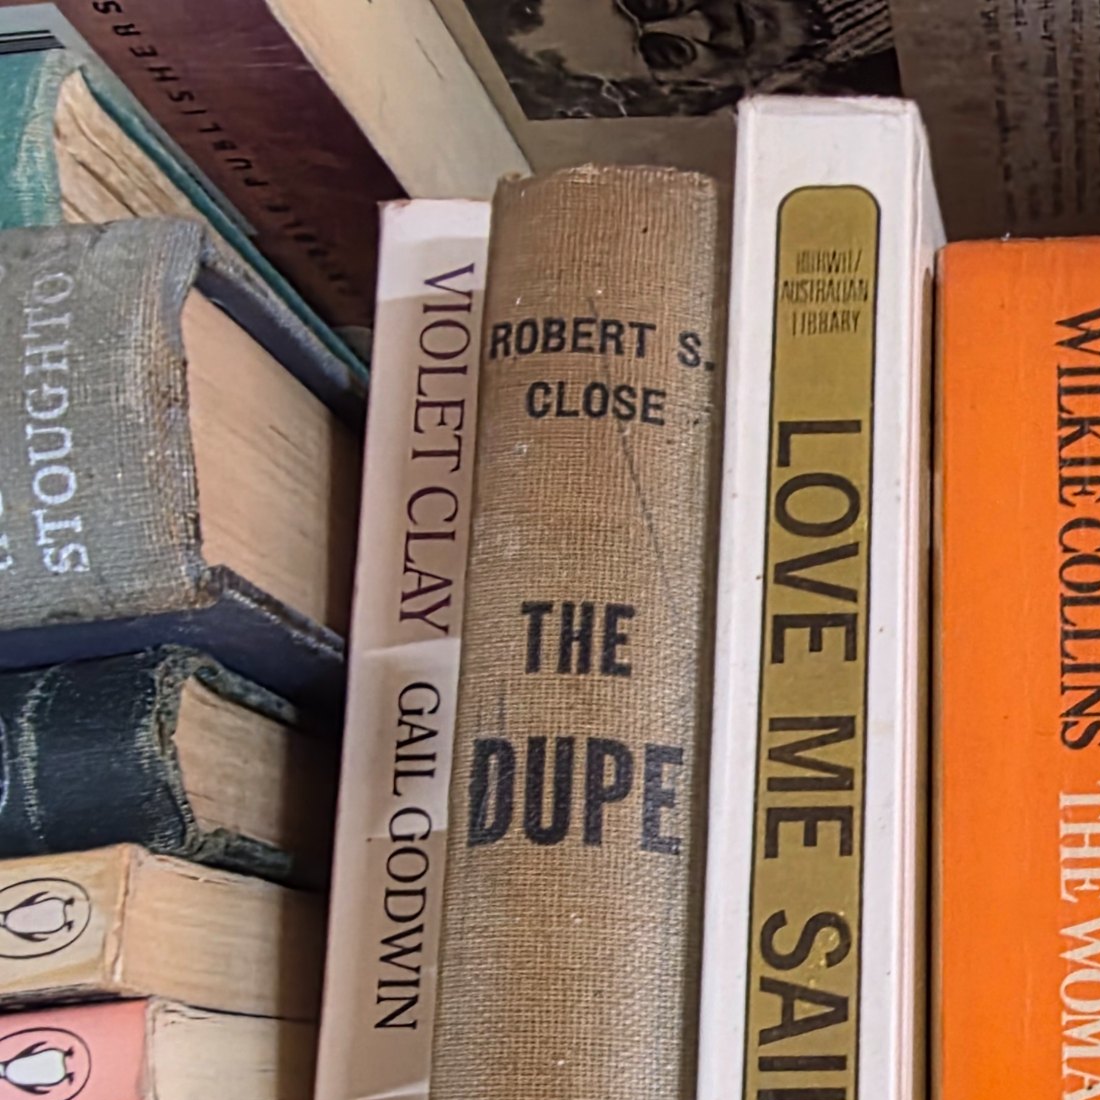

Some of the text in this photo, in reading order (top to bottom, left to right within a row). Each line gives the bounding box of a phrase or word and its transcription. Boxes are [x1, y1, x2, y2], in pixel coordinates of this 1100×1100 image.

[94, 0, 268, 188] PUBLISHERS
[489, 317, 715, 371] ROBERT S.
[791, 309, 861, 336] LIBRARY
[23, 253, 90, 573] STOUGHTO
[399, 263, 475, 634] VIOLET CLAY
[525, 381, 667, 425] CLOSE
[770, 419, 862, 664] LOVE
[520, 600, 637, 676] THE
[374, 682, 441, 1031] GAIL GODWIN
[466, 737, 684, 856] DUPE
[762, 715, 856, 860] ME
